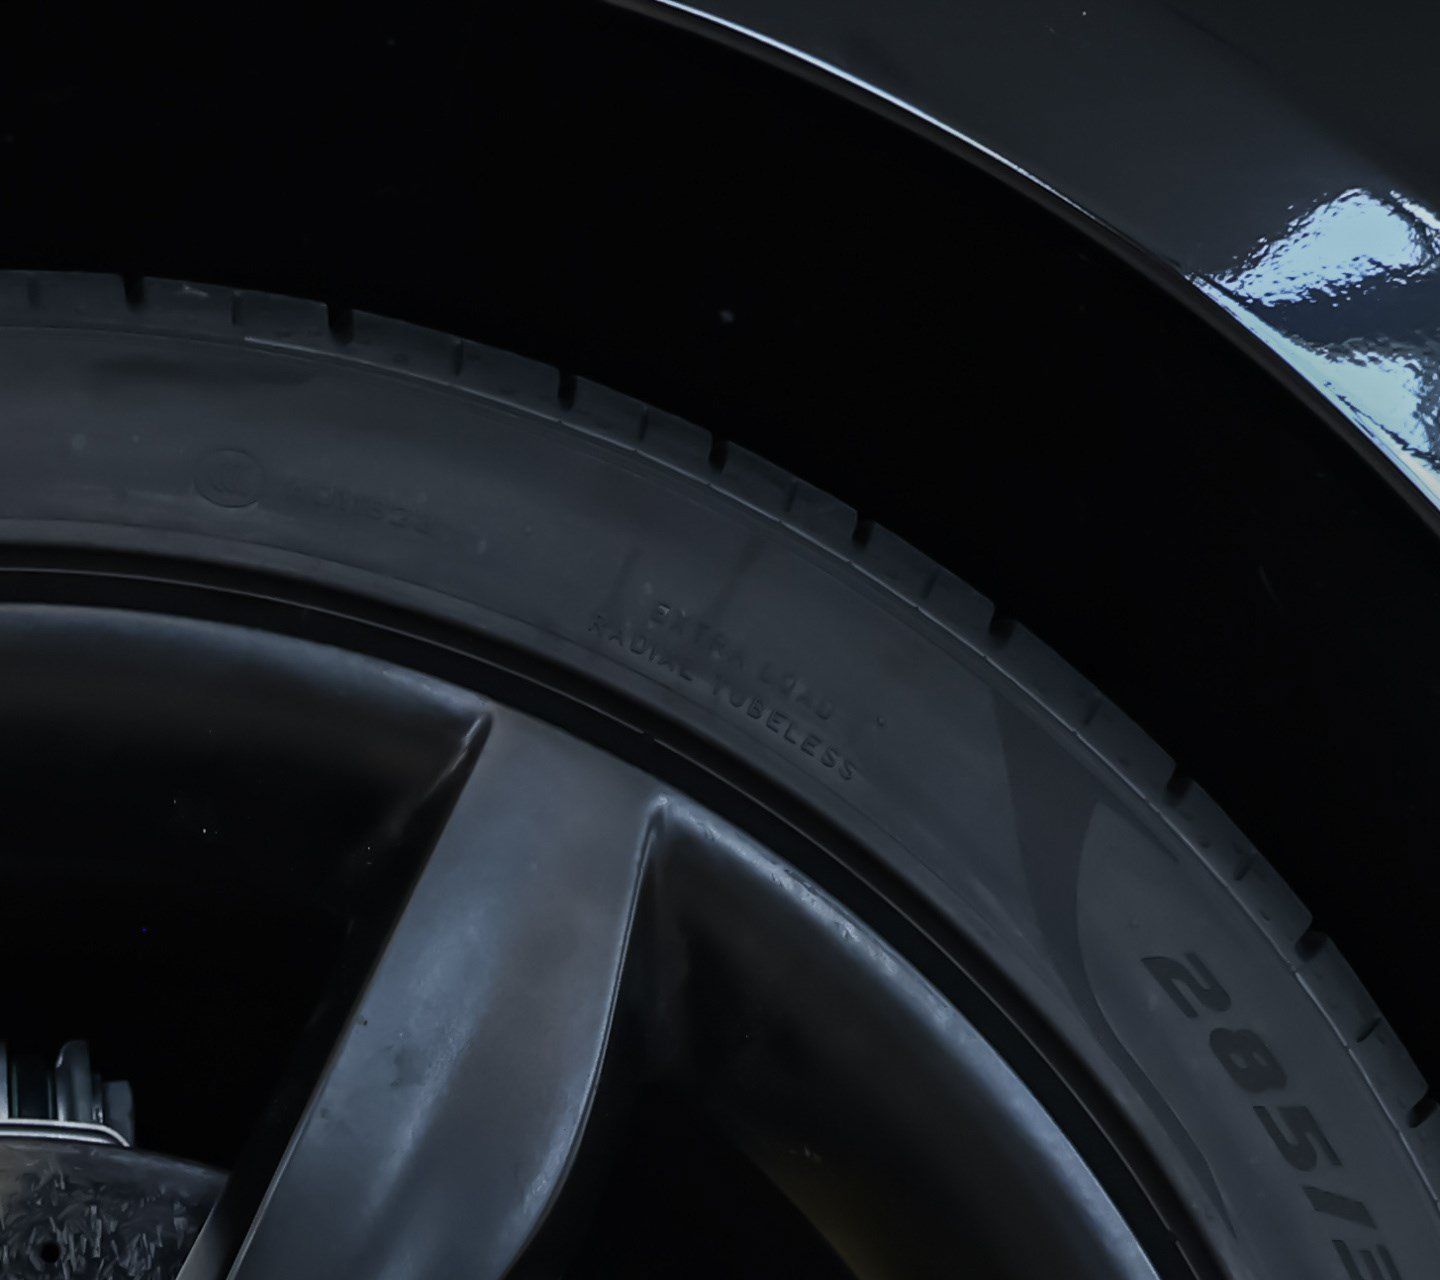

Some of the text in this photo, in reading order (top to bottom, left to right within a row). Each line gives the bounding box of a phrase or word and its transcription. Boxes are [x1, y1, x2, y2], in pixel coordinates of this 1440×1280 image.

[587, 611, 861, 784] RADIAL TUBELESS
[649, 599, 839, 724] EXTRA LOAD
